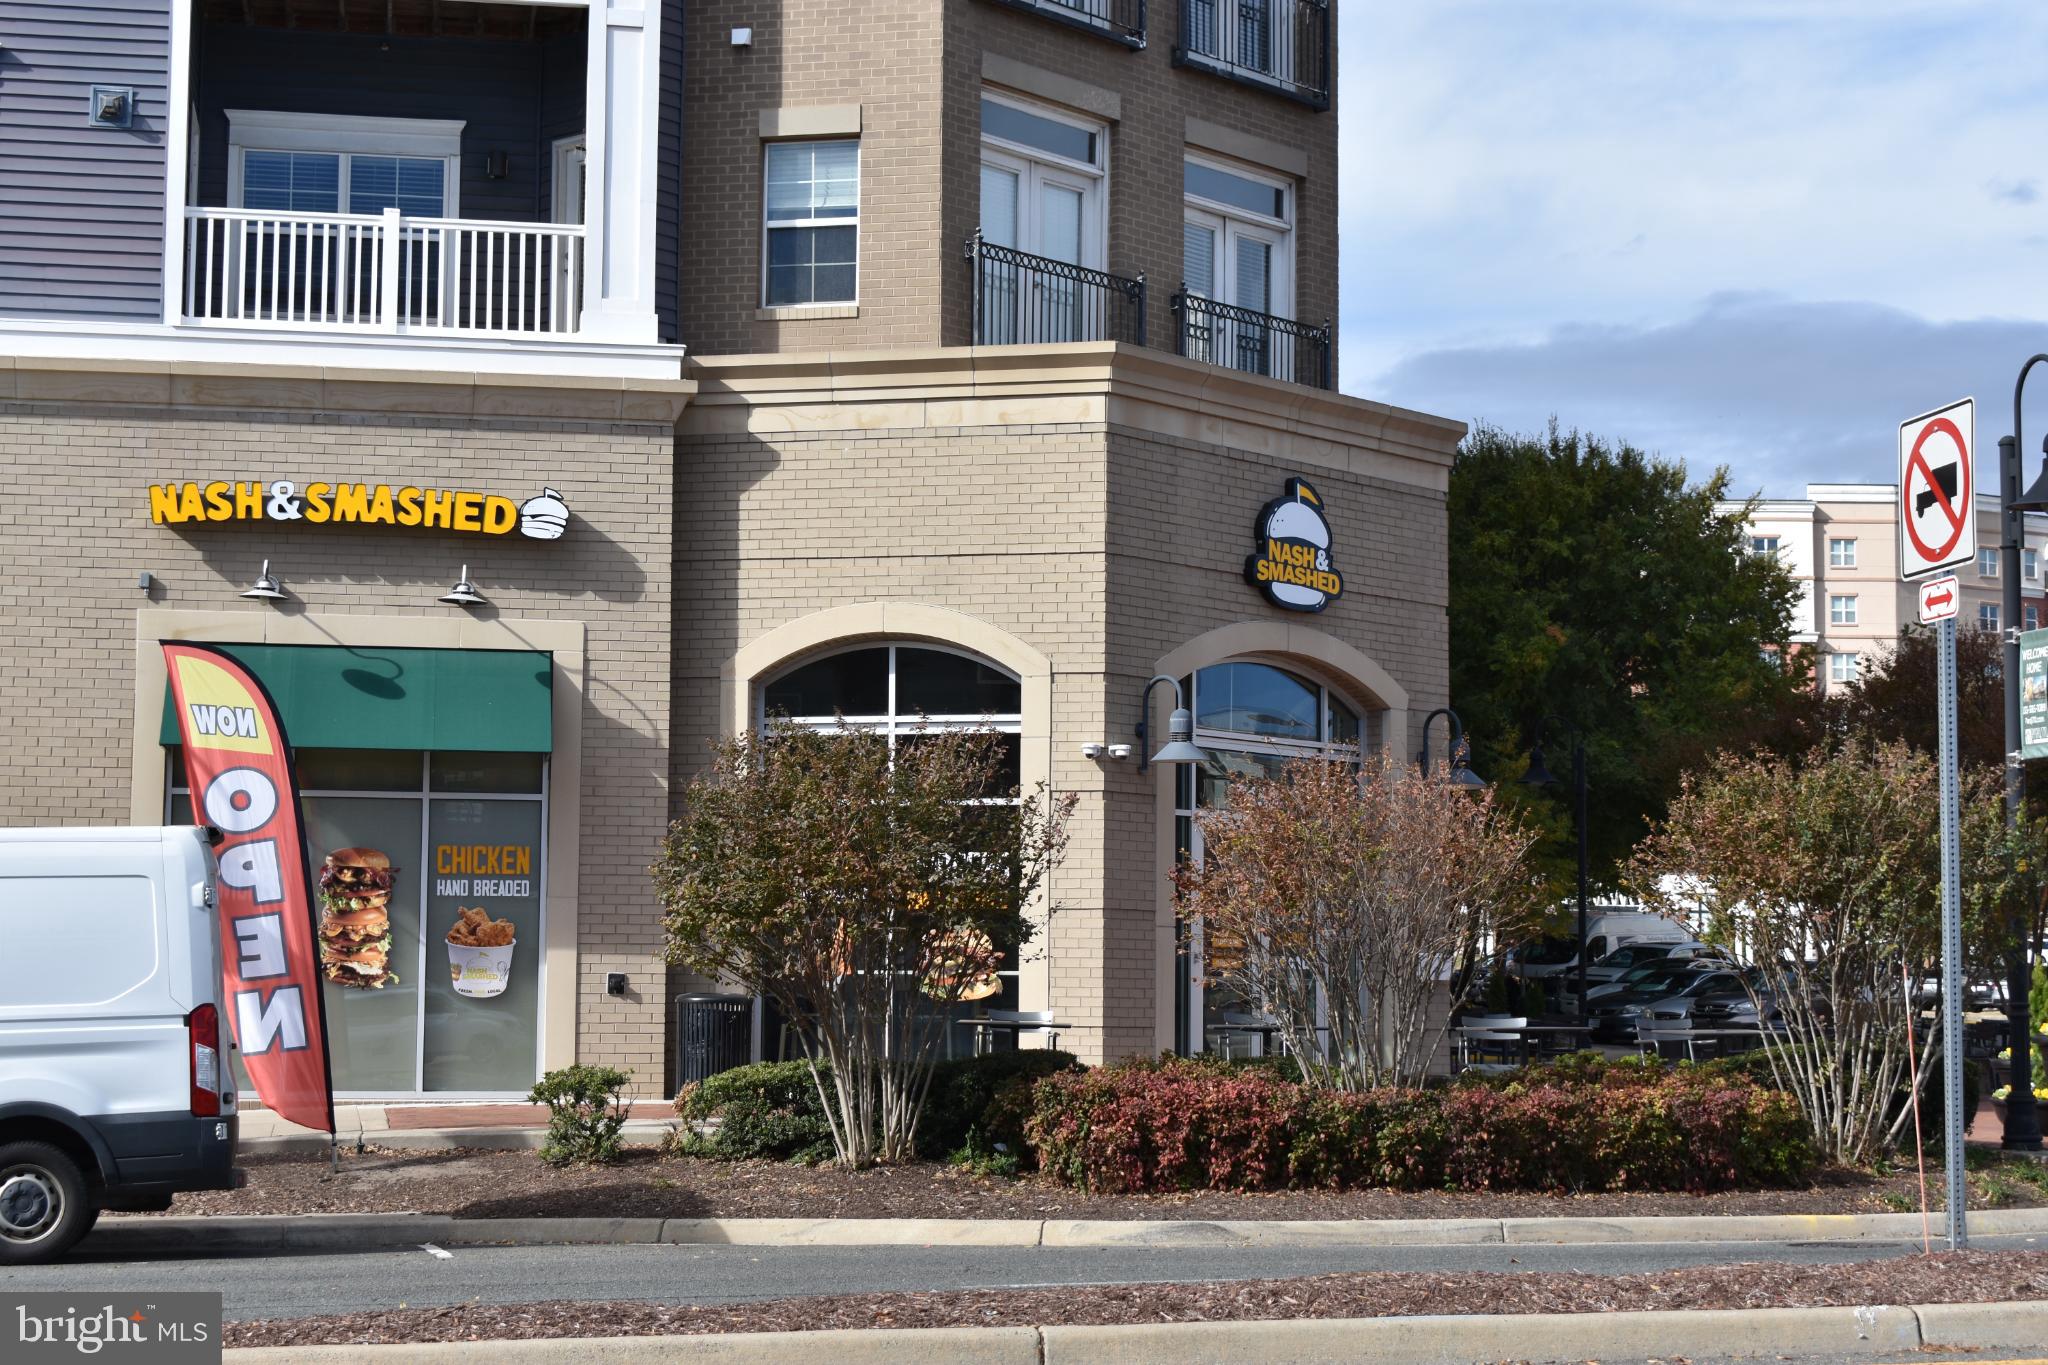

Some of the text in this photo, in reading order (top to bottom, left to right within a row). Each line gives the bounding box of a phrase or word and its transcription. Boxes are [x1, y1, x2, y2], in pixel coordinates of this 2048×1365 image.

[1256, 559, 1340, 595] SMASHED
[2026, 661, 2042, 673] HOME
[437, 845, 531, 875] CHICKEN
[437, 879, 530, 897] HAND BREADED
